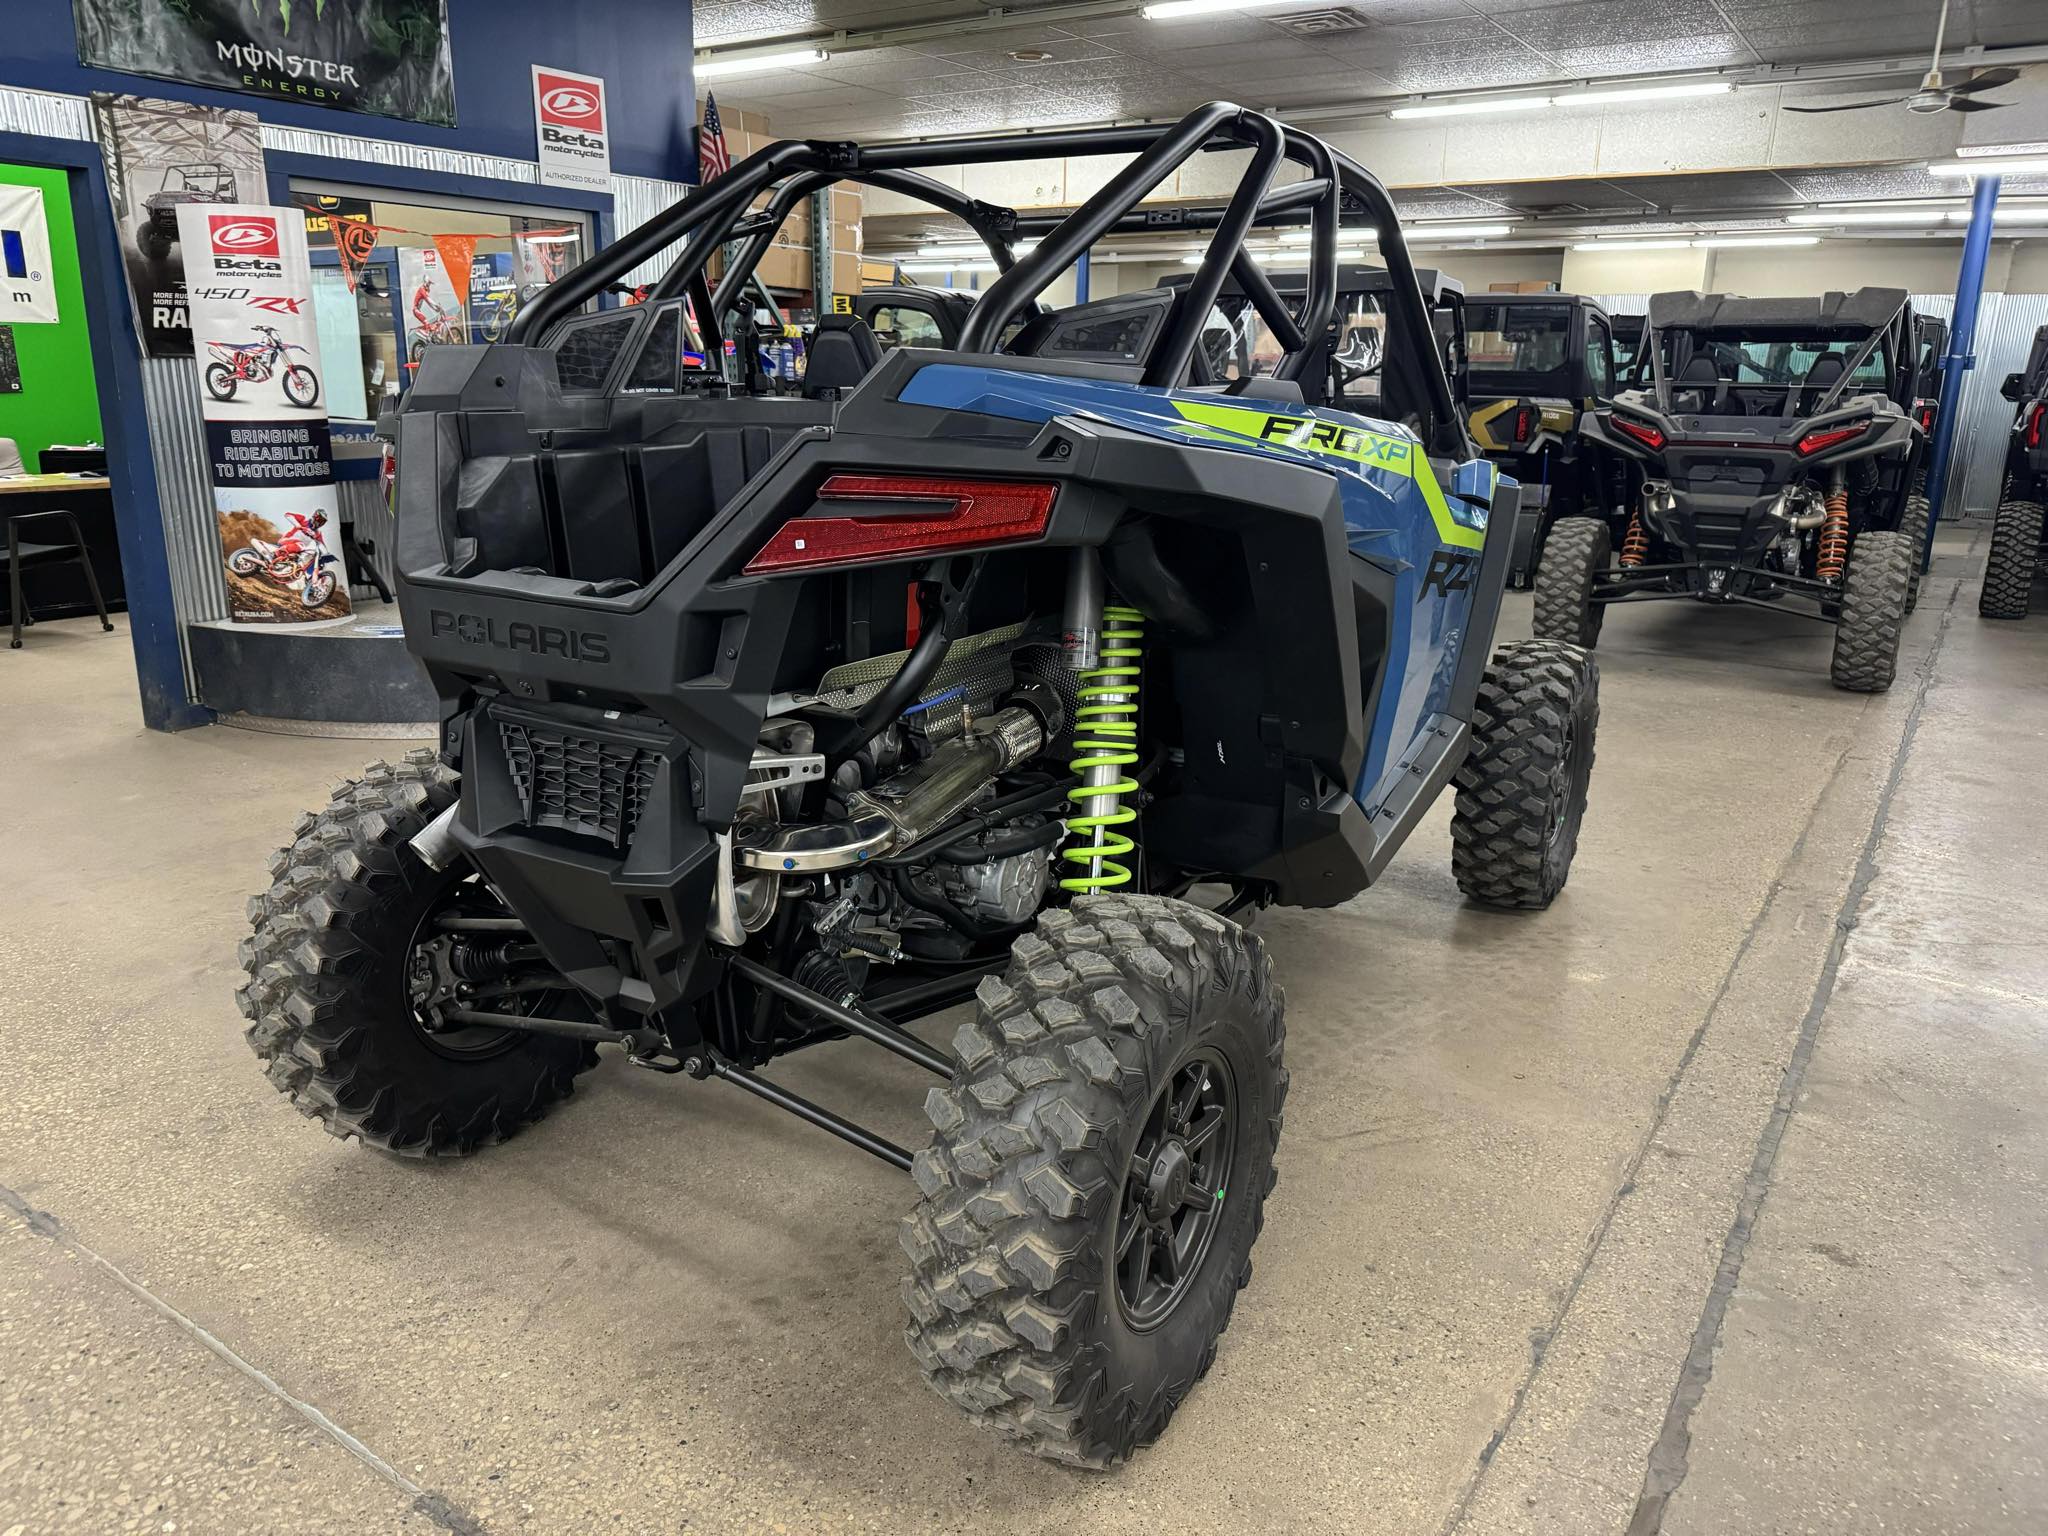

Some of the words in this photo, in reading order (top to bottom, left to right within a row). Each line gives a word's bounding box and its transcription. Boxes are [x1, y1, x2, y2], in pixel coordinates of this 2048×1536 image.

[216, 40, 360, 88] MONSTER
[243, 75, 341, 100] ENERGY
[542, 127, 604, 150] Beta
[99, 107, 122, 200] RANGER
[544, 144, 605, 158] motorcycles
[545, 170, 583, 183] AUTHORIZED
[584, 176, 607, 185] DEALER
[213, 258, 282, 270] Beta
[216, 271, 282, 279] motorcycles
[195, 288, 250, 299] 450
[230, 428, 310, 444] BRINGING
[1260, 416, 1362, 454] PRO
[1363, 437, 1408, 461] XP
[224, 445, 319, 460] RIDEABILITY
[216, 463, 235, 477] TO
[238, 461, 330, 478] MOTOCROSS
[430, 609, 610, 664] POLARIS
